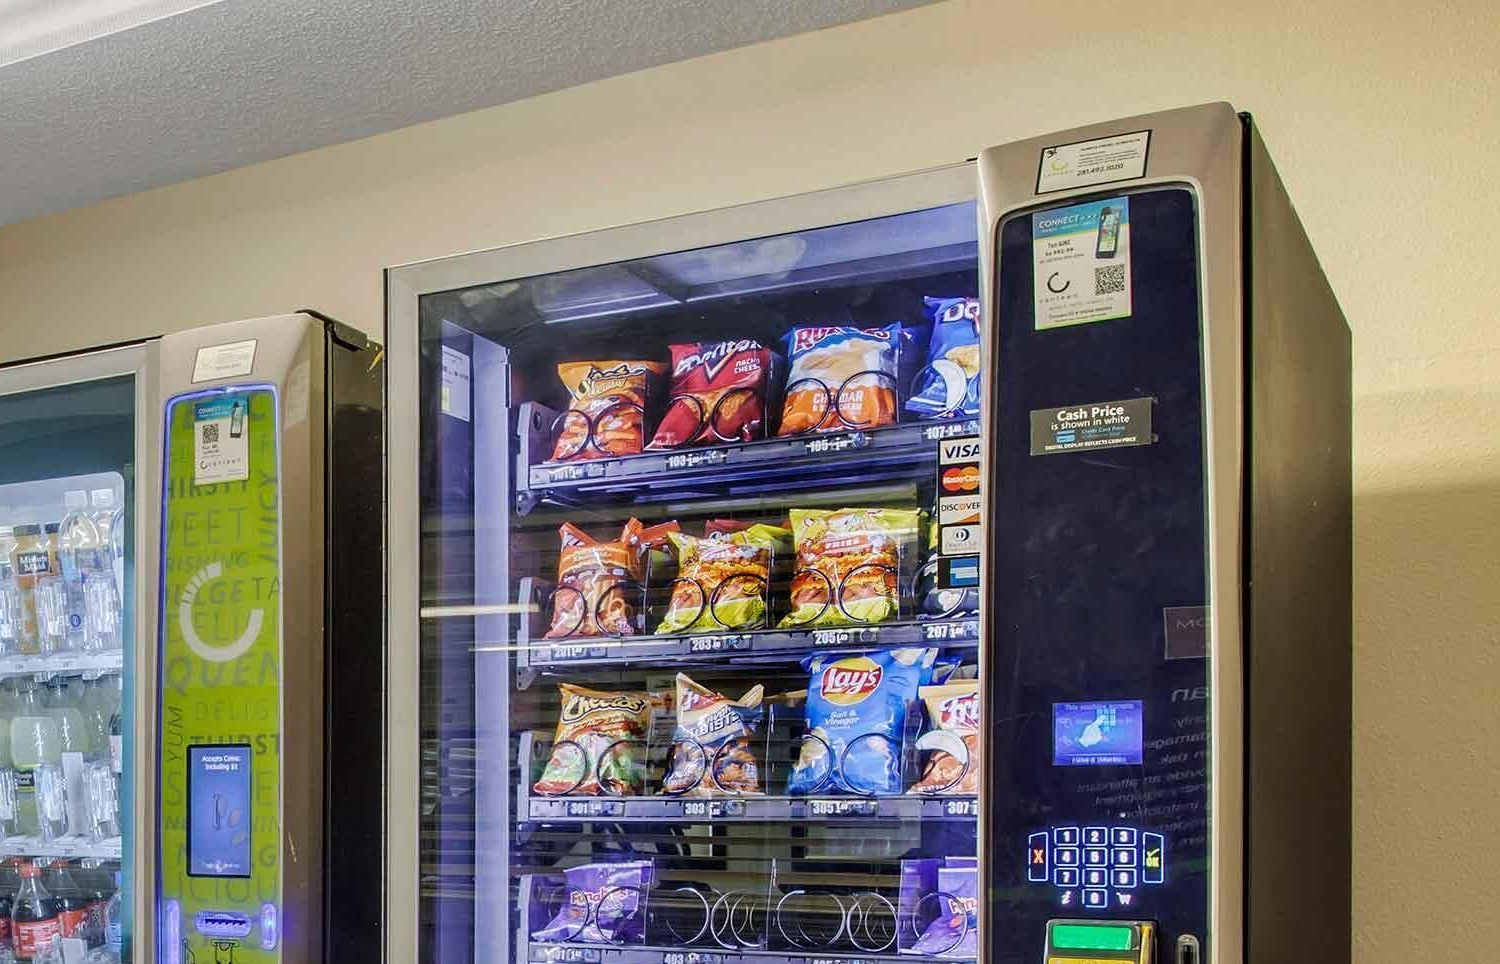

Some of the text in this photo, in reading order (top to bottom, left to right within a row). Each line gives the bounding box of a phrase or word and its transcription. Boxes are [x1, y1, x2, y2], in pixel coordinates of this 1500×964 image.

[1057, 405, 1125, 421] Cash Price
[1051, 414, 1131, 431] is shown in white
[945, 444, 980, 459] VISA
[685, 802, 705, 815] 303
[948, 801, 970, 815] 307
[1062, 831, 1071, 842] 1
[1090, 831, 1100, 842] 2
[1119, 831, 1129, 842] 3
[1062, 872, 1071, 884] 7
[1119, 872, 1129, 884] 9
[1090, 892, 1100, 904] 0
